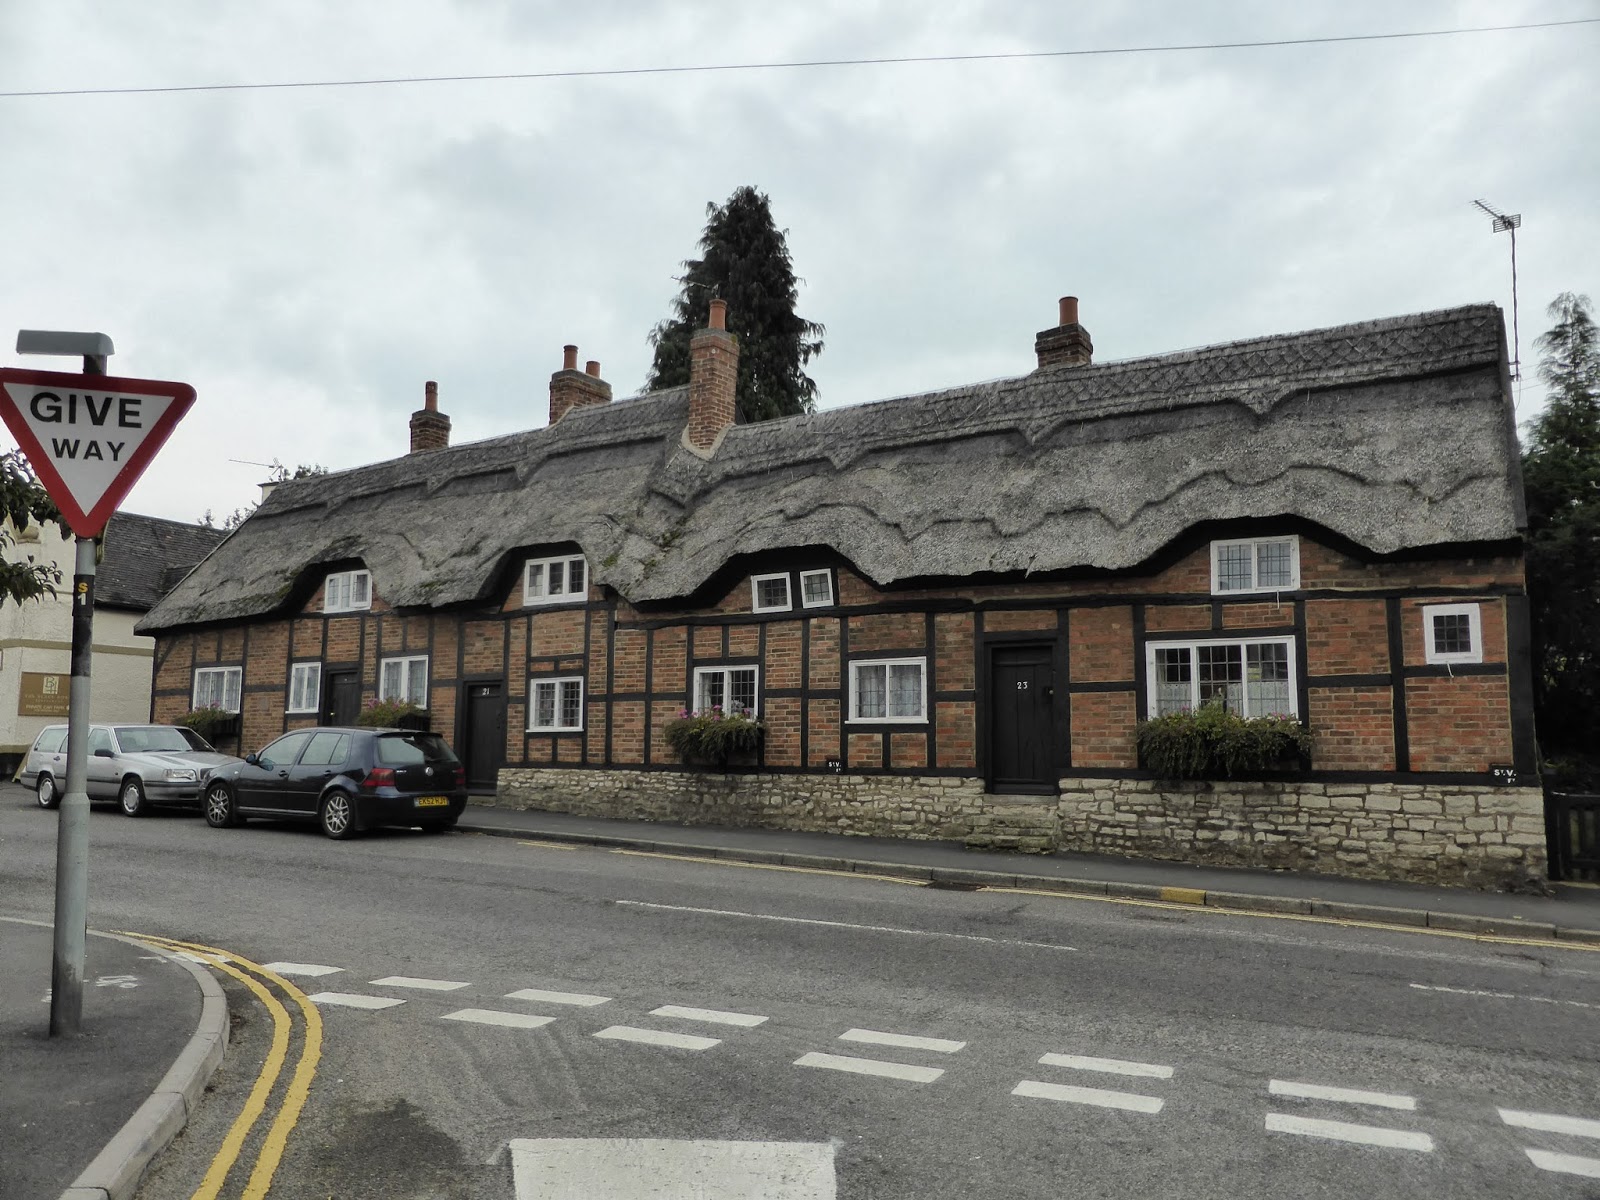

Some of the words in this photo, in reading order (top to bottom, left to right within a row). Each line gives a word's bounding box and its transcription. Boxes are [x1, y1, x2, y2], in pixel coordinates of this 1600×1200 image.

[30, 391, 142, 428] GIVE
[52, 438, 125, 461] WAY
[78, 582, 88, 593] S
[77, 593, 87, 606] 1
[482, 687, 490, 695] 21
[1016, 681, 1028, 690] 23
